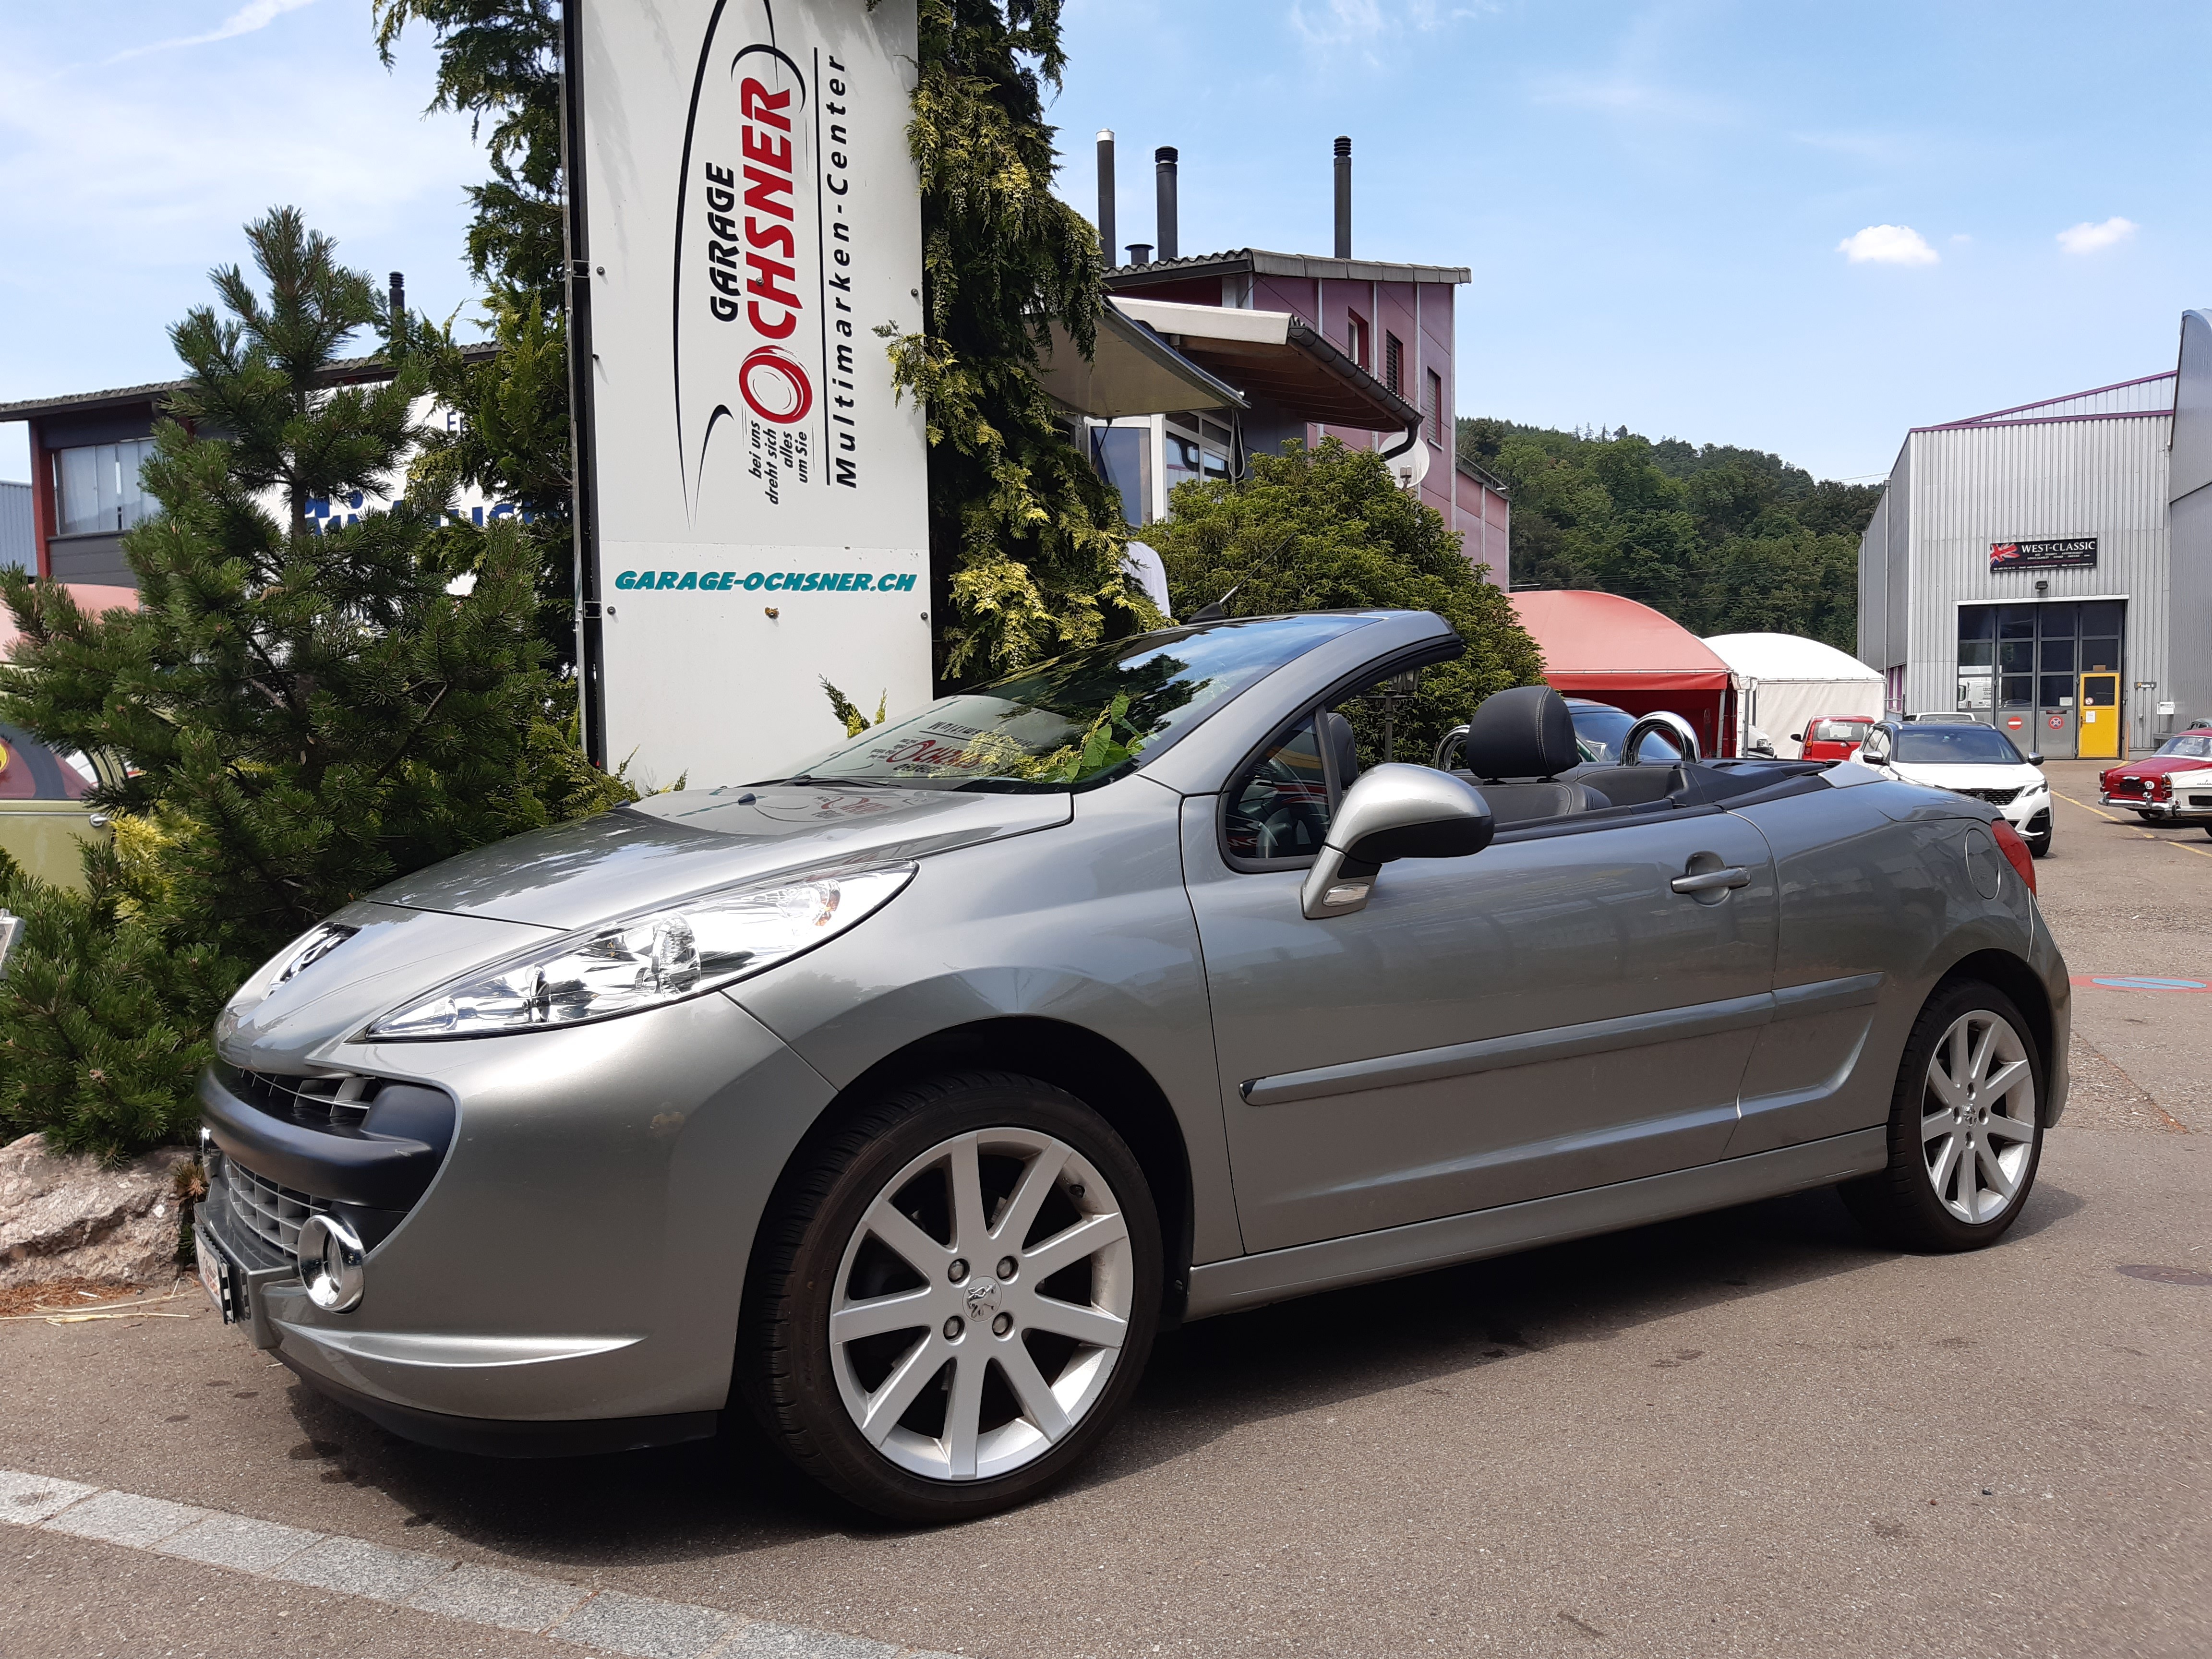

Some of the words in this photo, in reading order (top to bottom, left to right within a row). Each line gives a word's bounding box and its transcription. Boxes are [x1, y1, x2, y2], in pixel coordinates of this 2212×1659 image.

[706, 162, 742, 322] GARAGE
[739, 77, 813, 424] OCHSNER
[826, 55, 857, 489] Multimarken-Center
[751, 420, 761, 449] uns
[763, 428, 777, 459] sich
[794, 431, 808, 457] Sie
[748, 450, 762, 480] bei
[779, 431, 793, 469] alles
[764, 461, 779, 505] dreht
[798, 459, 808, 483] um
[2021, 541, 2095, 553] WEST-CLASSIC
[614, 570, 918, 592] GARAGE-OCHSNER.CH
